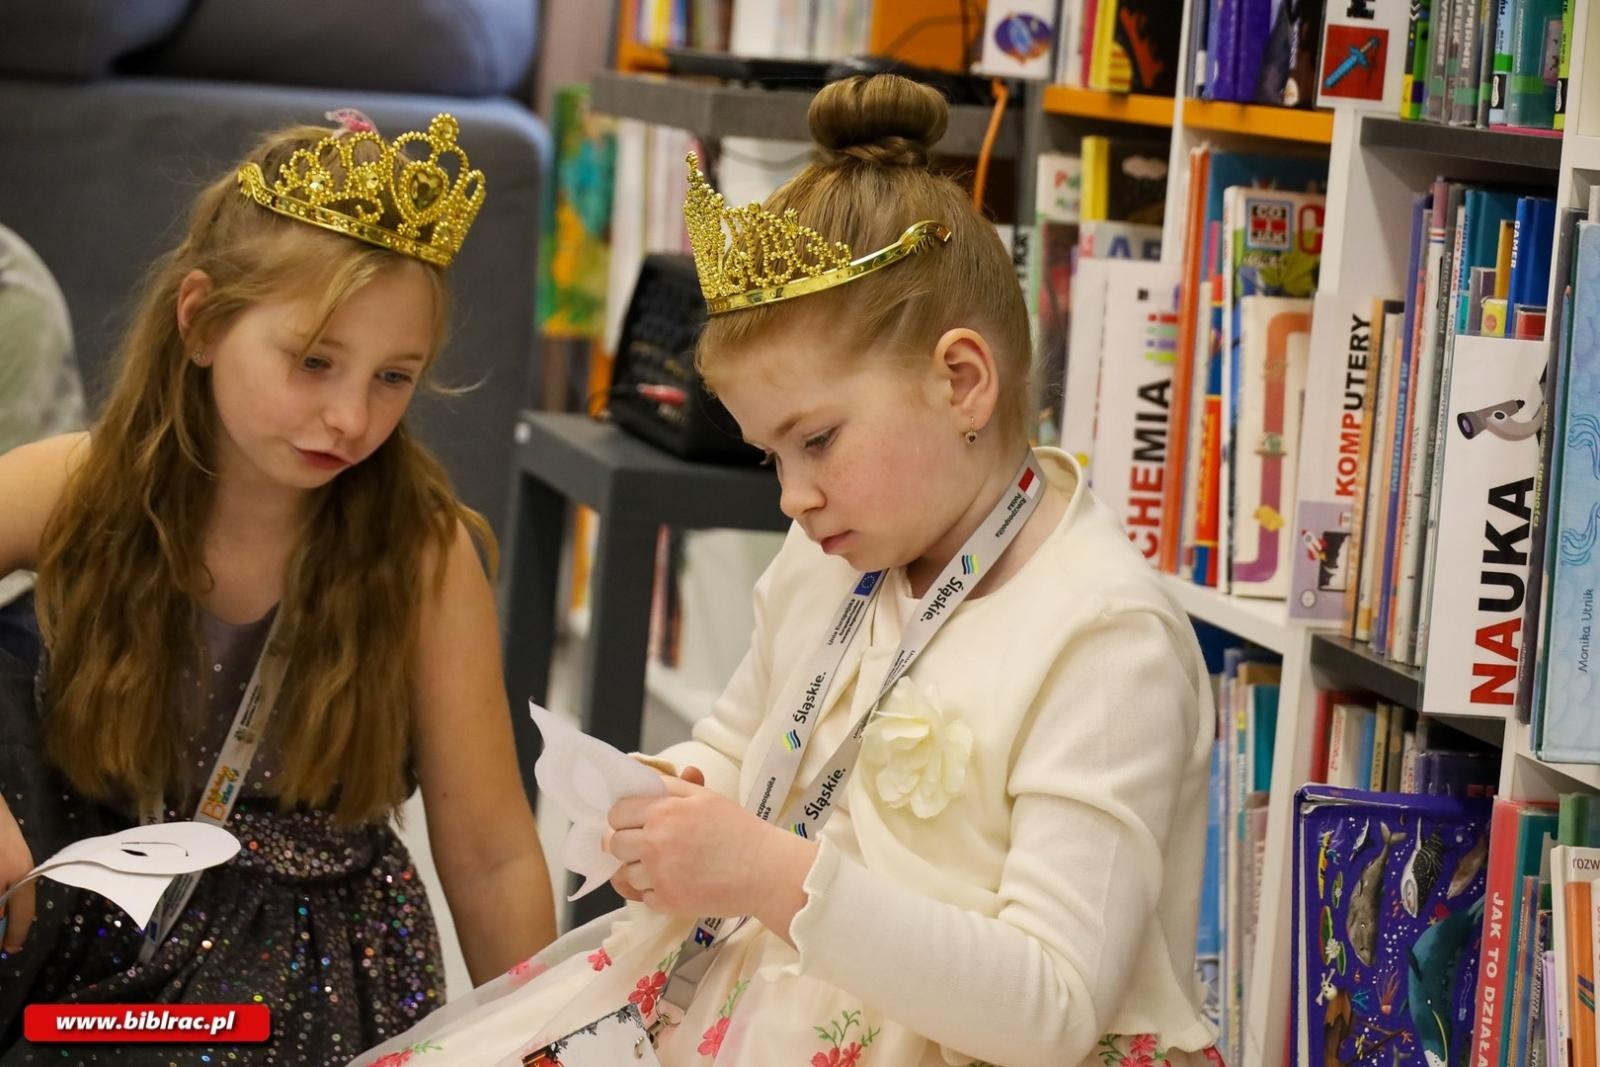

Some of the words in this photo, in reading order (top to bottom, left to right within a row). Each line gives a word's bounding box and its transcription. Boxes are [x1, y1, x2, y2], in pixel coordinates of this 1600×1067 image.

[1510, 220, 1521, 269] GAMER
[1441, 251, 1452, 292] Marcin
[1335, 313, 1373, 497] KOMPUTERY
[1126, 378, 1172, 559] CHEMIA
[921, 577, 963, 623] Śląskie.
[1469, 476, 1535, 705] NAUKA
[1583, 588, 1595, 622] Utnik
[1579, 625, 1591, 673] Monika
[792, 671, 827, 724] Śląskie.
[756, 776, 777, 818] eczpospolita
[762, 806, 772, 821] lska
[805, 767, 847, 820] Śląskie.
[1489, 892, 1505, 939] JAK
[1486, 947, 1500, 979] TO
[1476, 986, 1496, 1067] DZIAŁA
